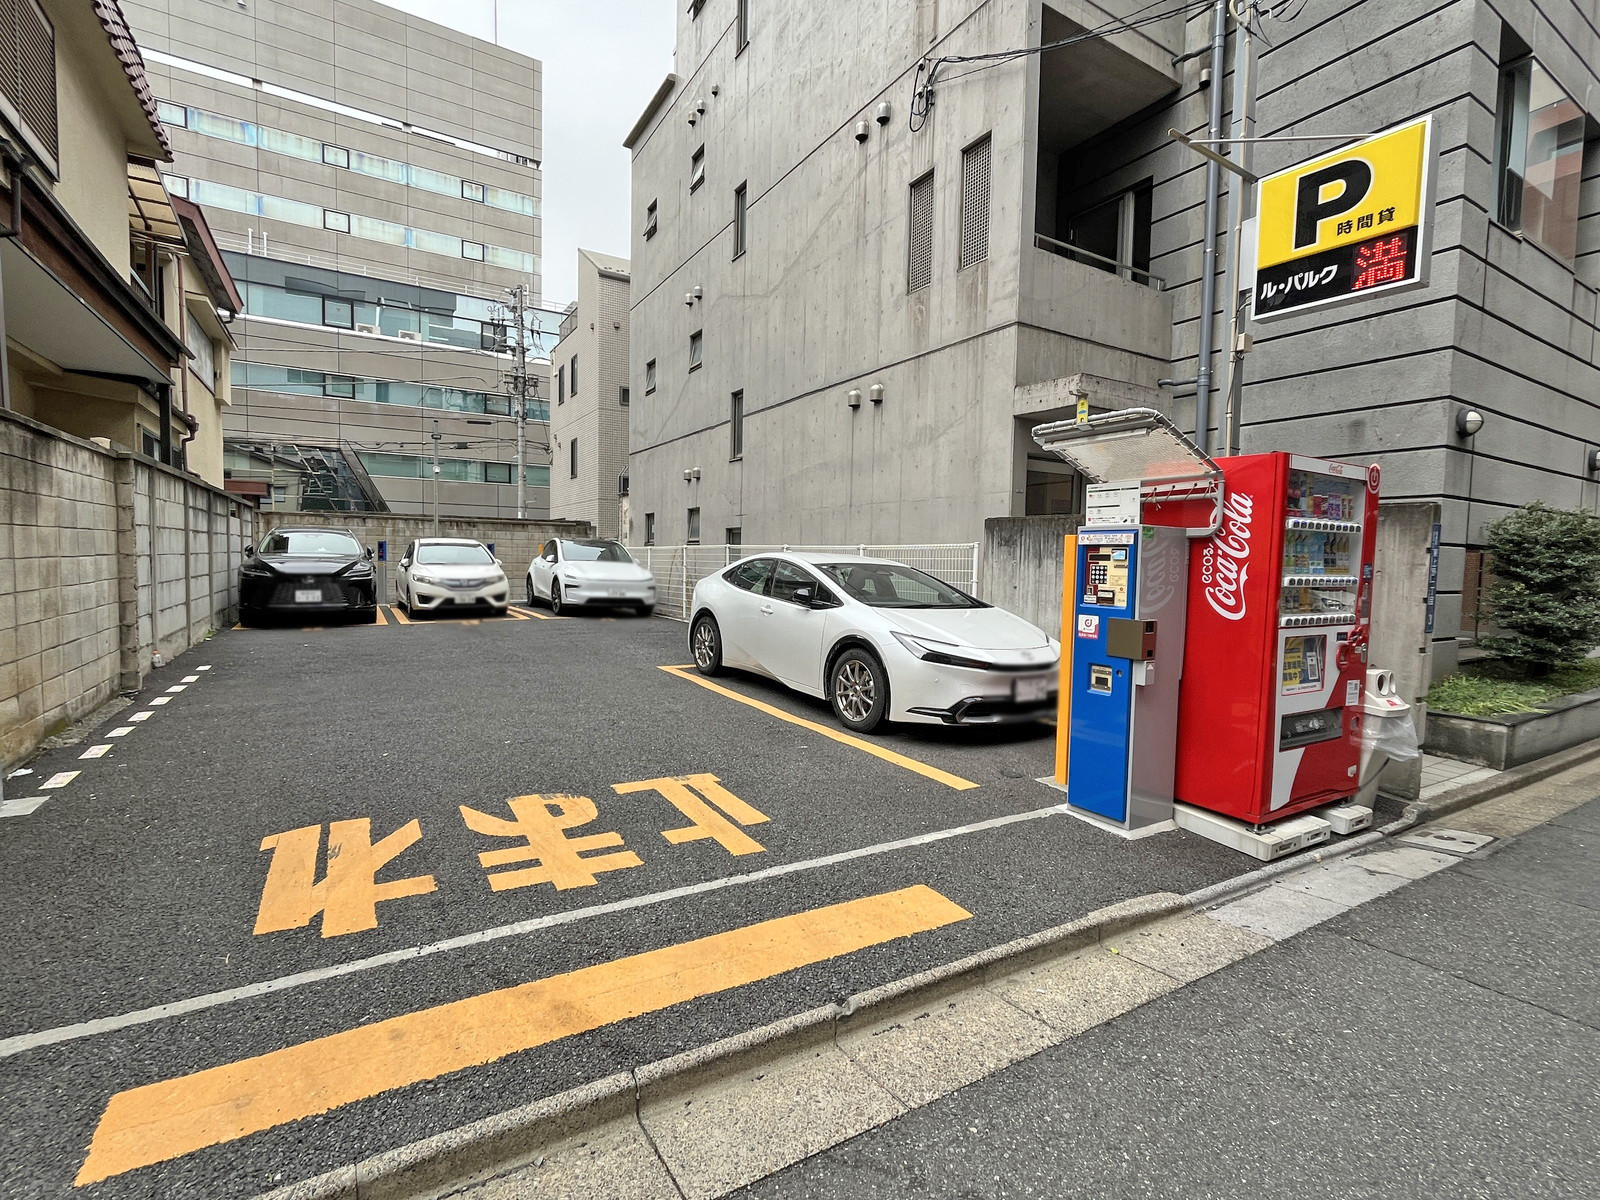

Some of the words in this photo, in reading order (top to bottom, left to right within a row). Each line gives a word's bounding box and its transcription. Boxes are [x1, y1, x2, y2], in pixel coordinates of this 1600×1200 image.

[1294, 159, 1373, 250] P
[1337, 207, 1396, 237] 時間貸
[1352, 236, 1407, 291] 満
[1205, 492, 1253, 620] Coca-Cola
[252, 773, 771, 939] 止まれ
